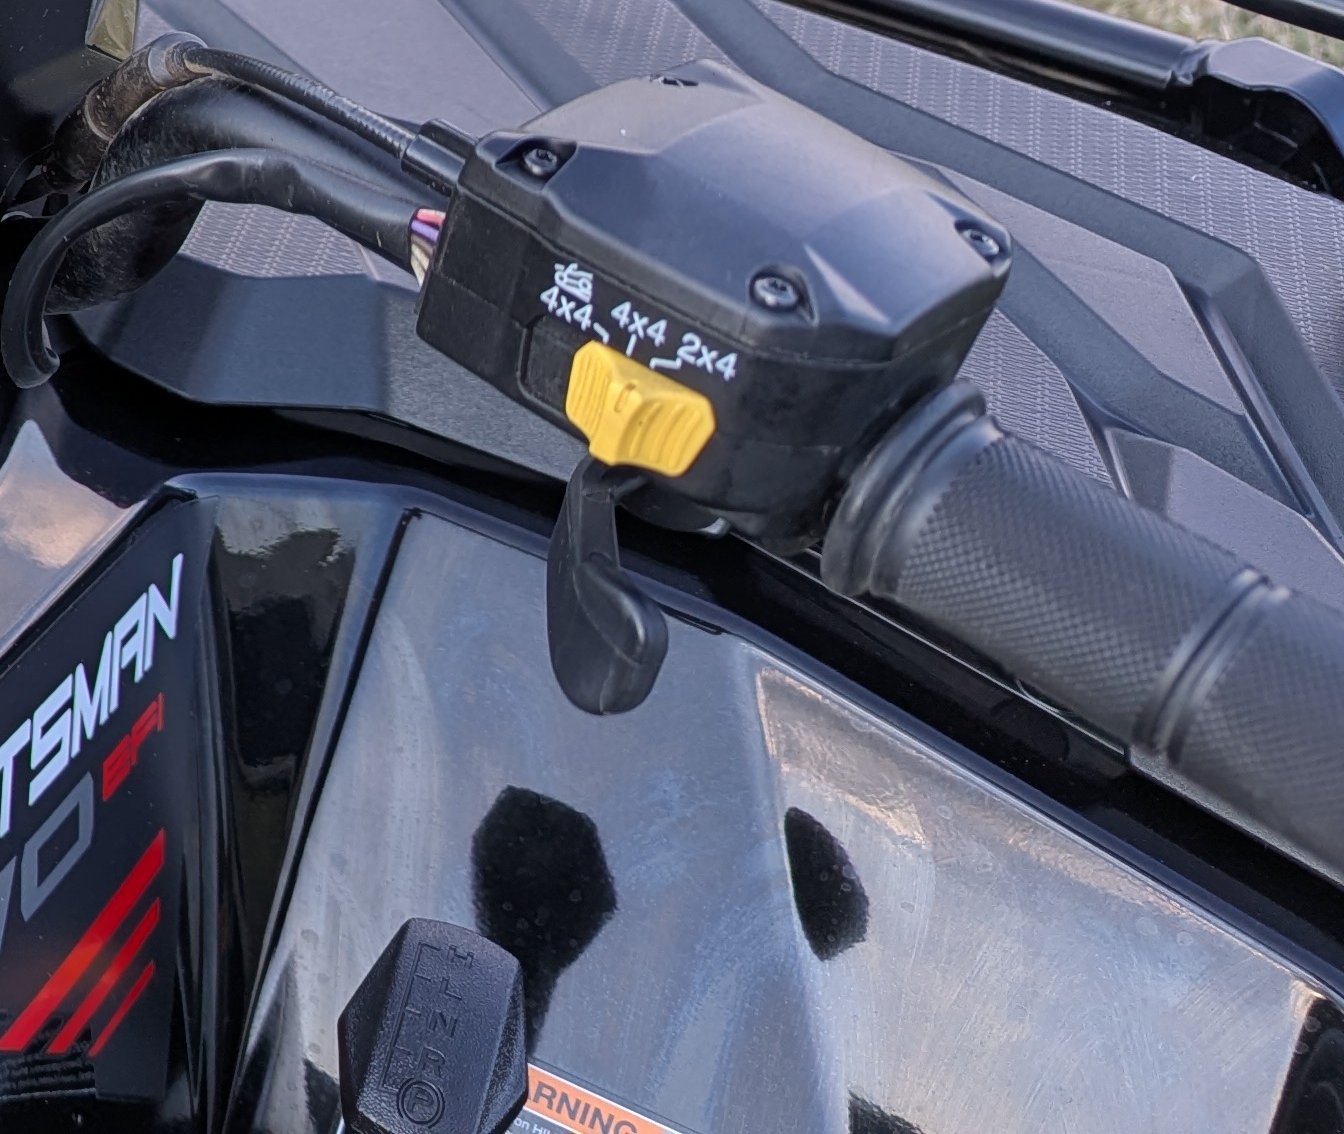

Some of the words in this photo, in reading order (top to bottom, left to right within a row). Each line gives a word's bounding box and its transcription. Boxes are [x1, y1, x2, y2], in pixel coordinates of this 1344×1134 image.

[102, 692, 165, 802] EFI
[438, 976, 463, 1001] L
[427, 1010, 458, 1038] N
[417, 1045, 446, 1079] R
[406, 1086, 435, 1114] P
